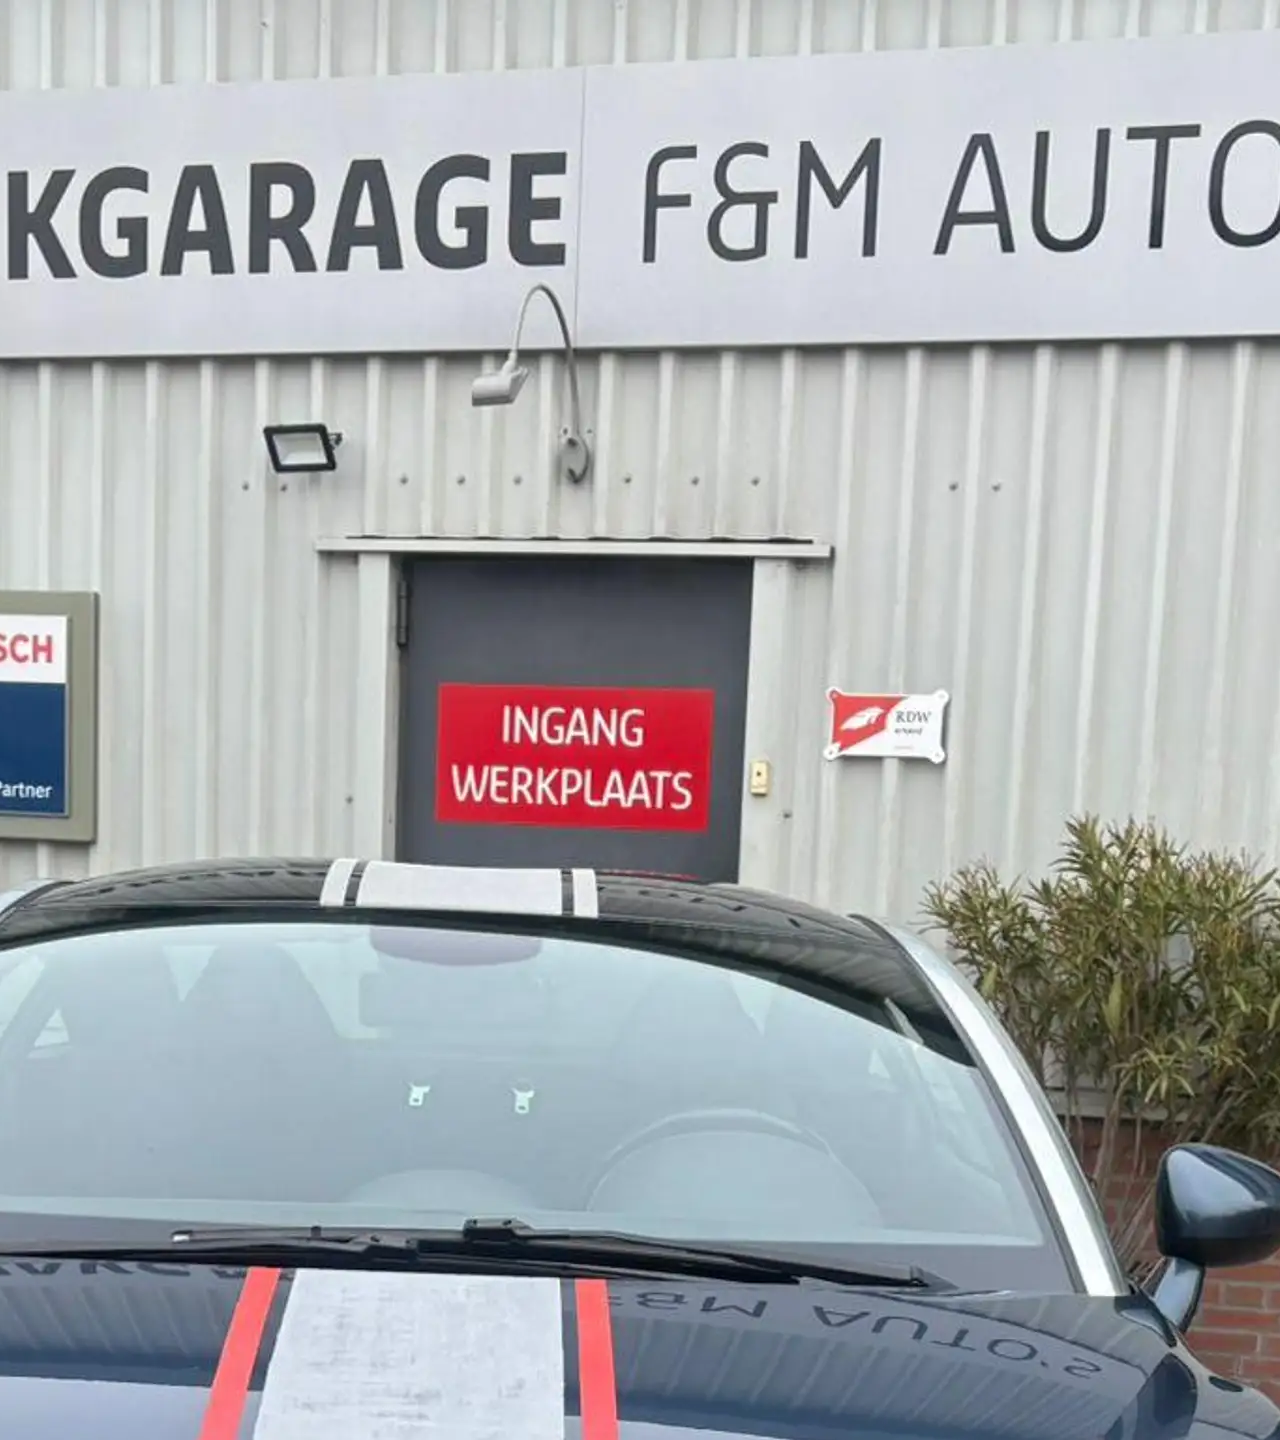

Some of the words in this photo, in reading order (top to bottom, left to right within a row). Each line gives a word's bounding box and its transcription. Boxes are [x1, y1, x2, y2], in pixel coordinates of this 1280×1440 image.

[642, 138, 882, 263] F&M
[502, 704, 645, 748] INGANG
[895, 710, 932, 724] RDW
[451, 763, 693, 810] WERKPLAATS
